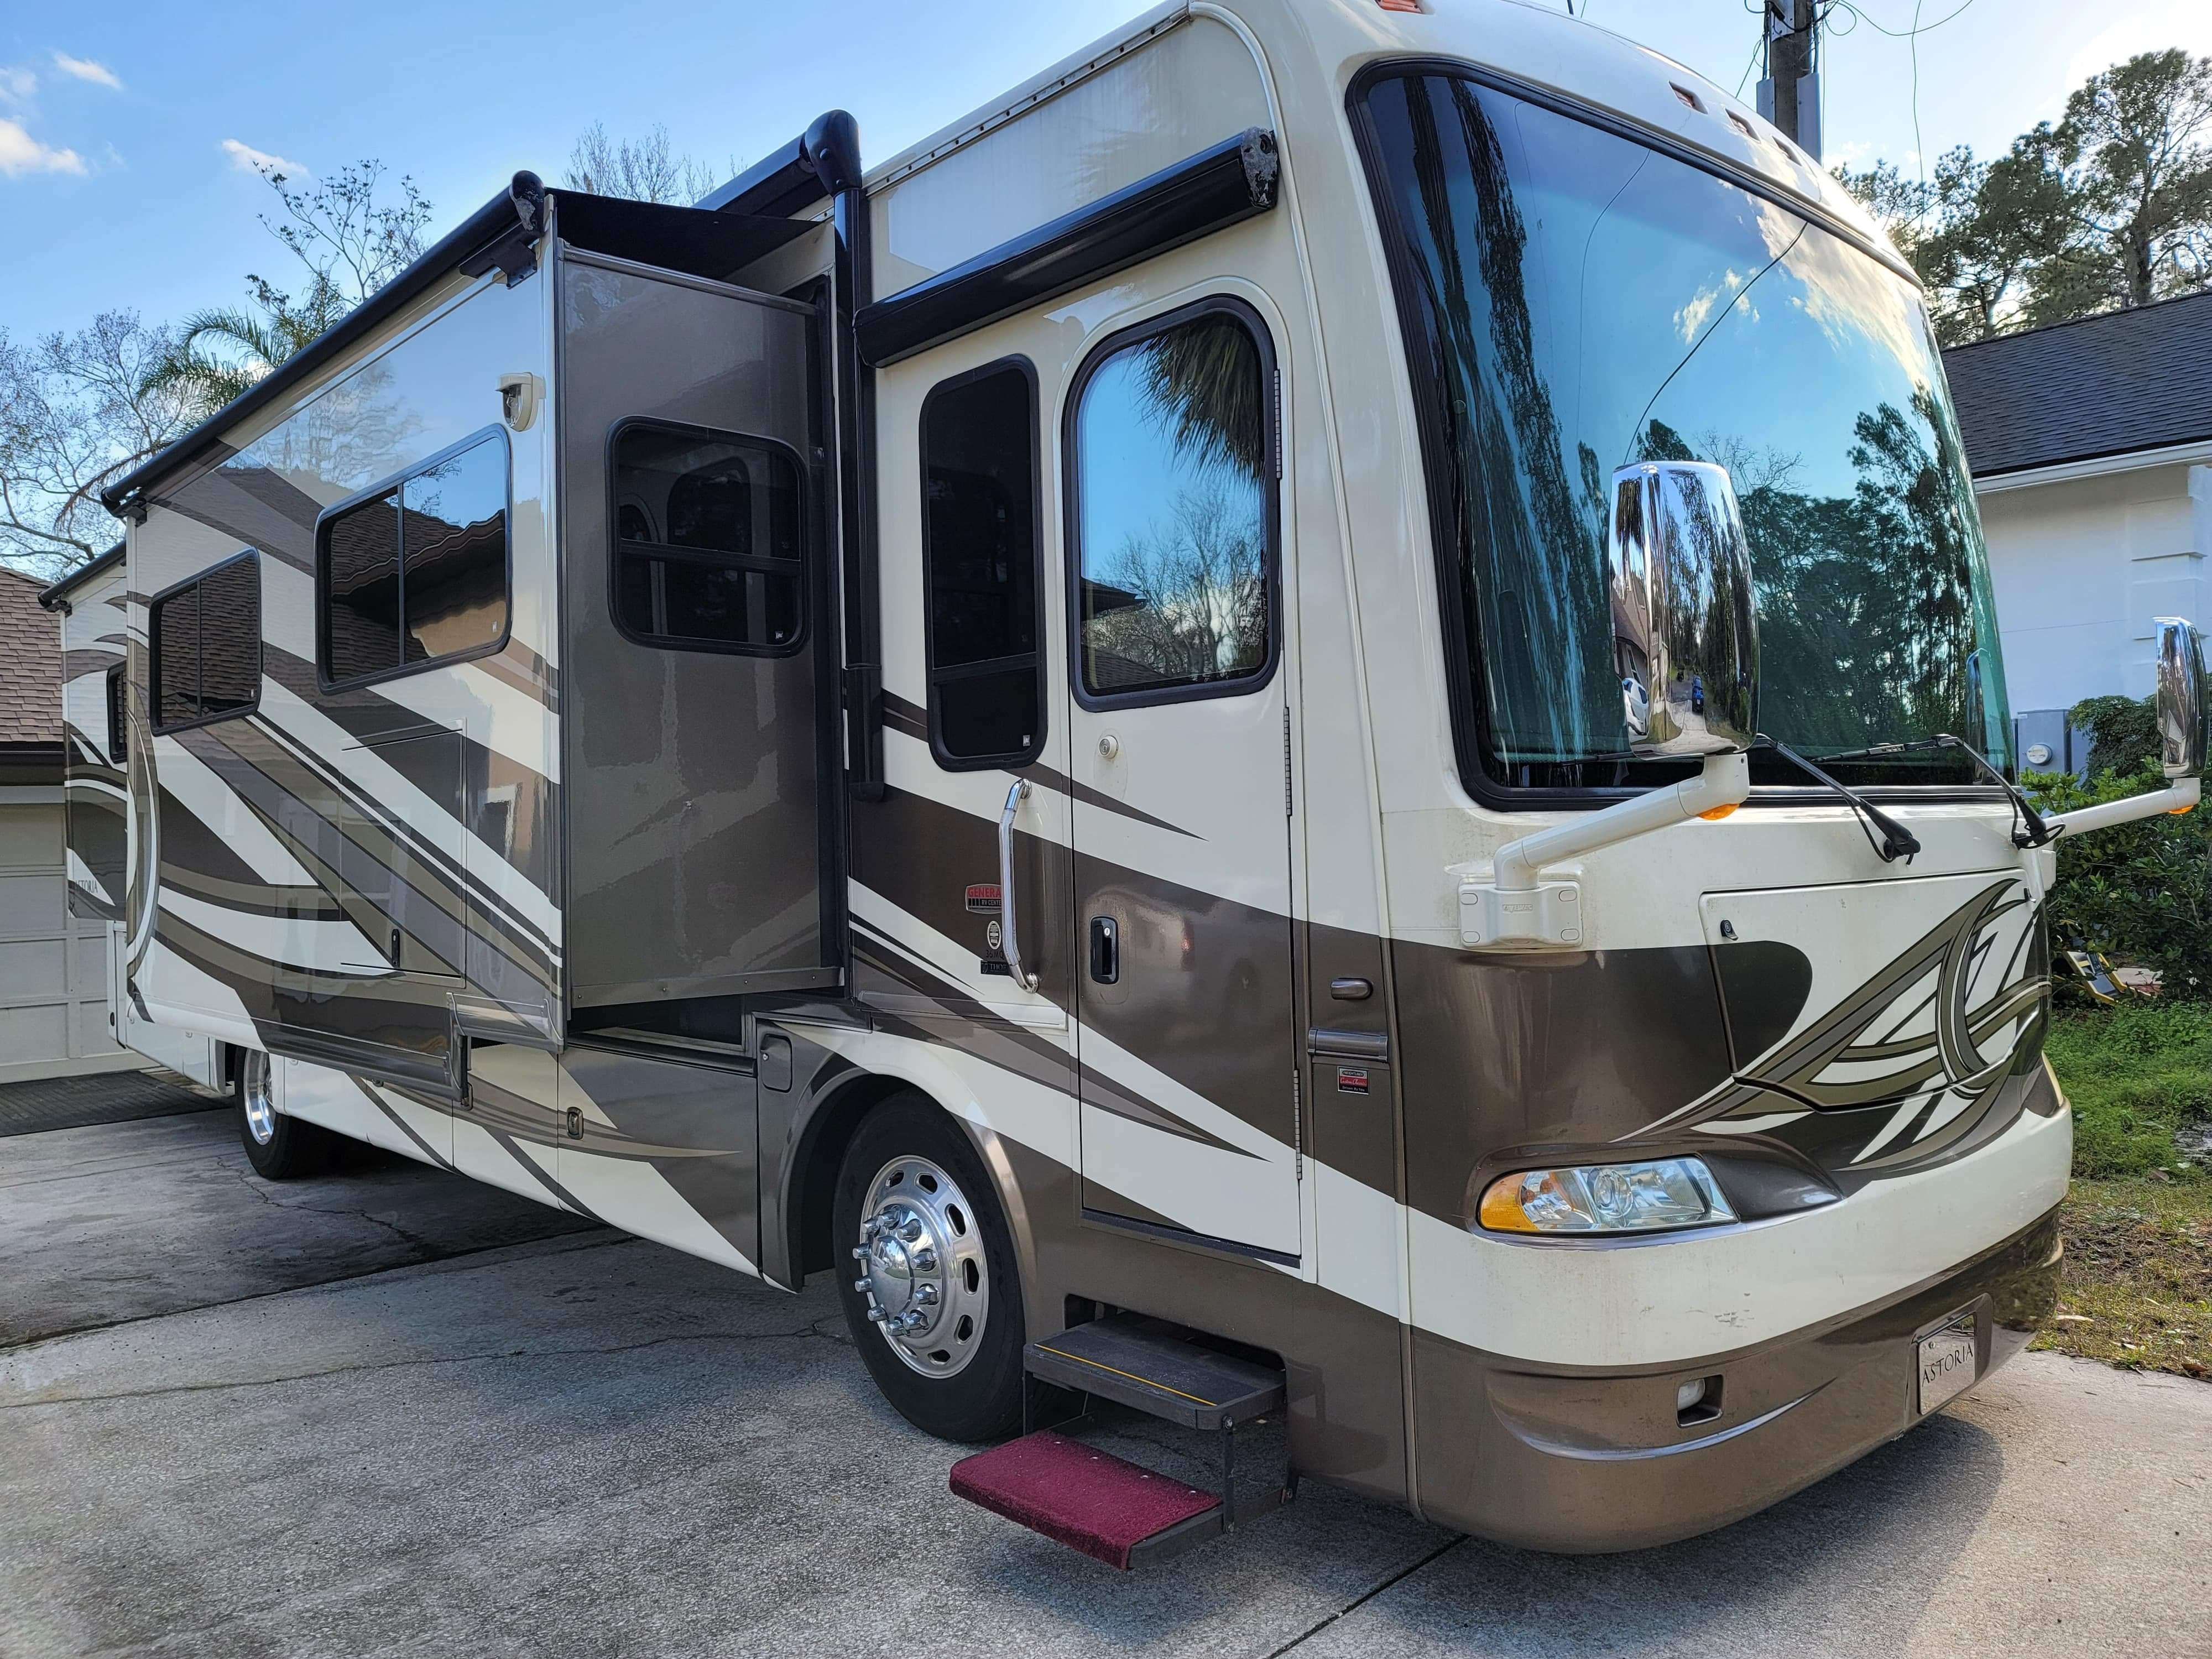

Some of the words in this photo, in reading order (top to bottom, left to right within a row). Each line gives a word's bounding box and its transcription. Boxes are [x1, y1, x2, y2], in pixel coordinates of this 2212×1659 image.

[75, 880, 98, 893] TORIA
[968, 888, 1001, 898] GENERA
[1922, 1342, 1973, 1387] ASTORIA
